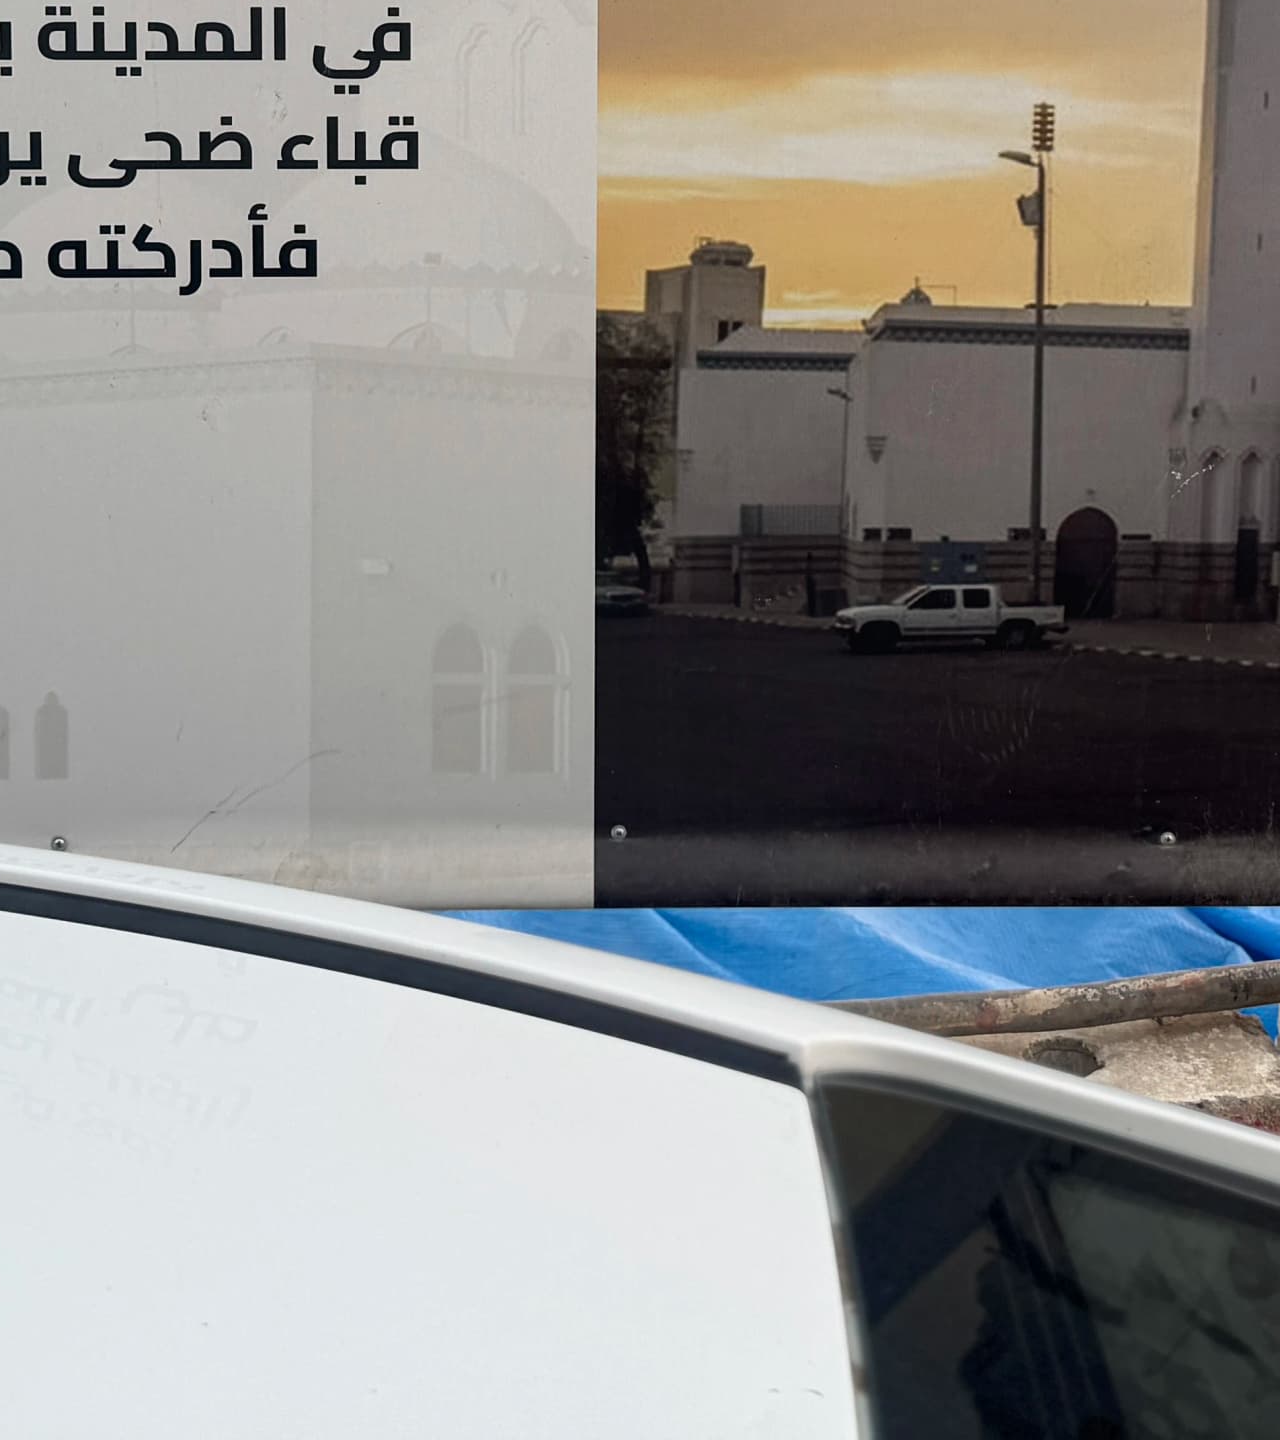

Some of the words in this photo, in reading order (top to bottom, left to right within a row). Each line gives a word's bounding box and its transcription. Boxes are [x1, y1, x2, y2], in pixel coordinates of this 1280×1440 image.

[37, 5, 287, 77] المدينة
[312, 6, 412, 95] في
[67, 116, 253, 189] ضحى
[276, 115, 419, 186] قباء
[47, 203, 318, 296] فأدركته
